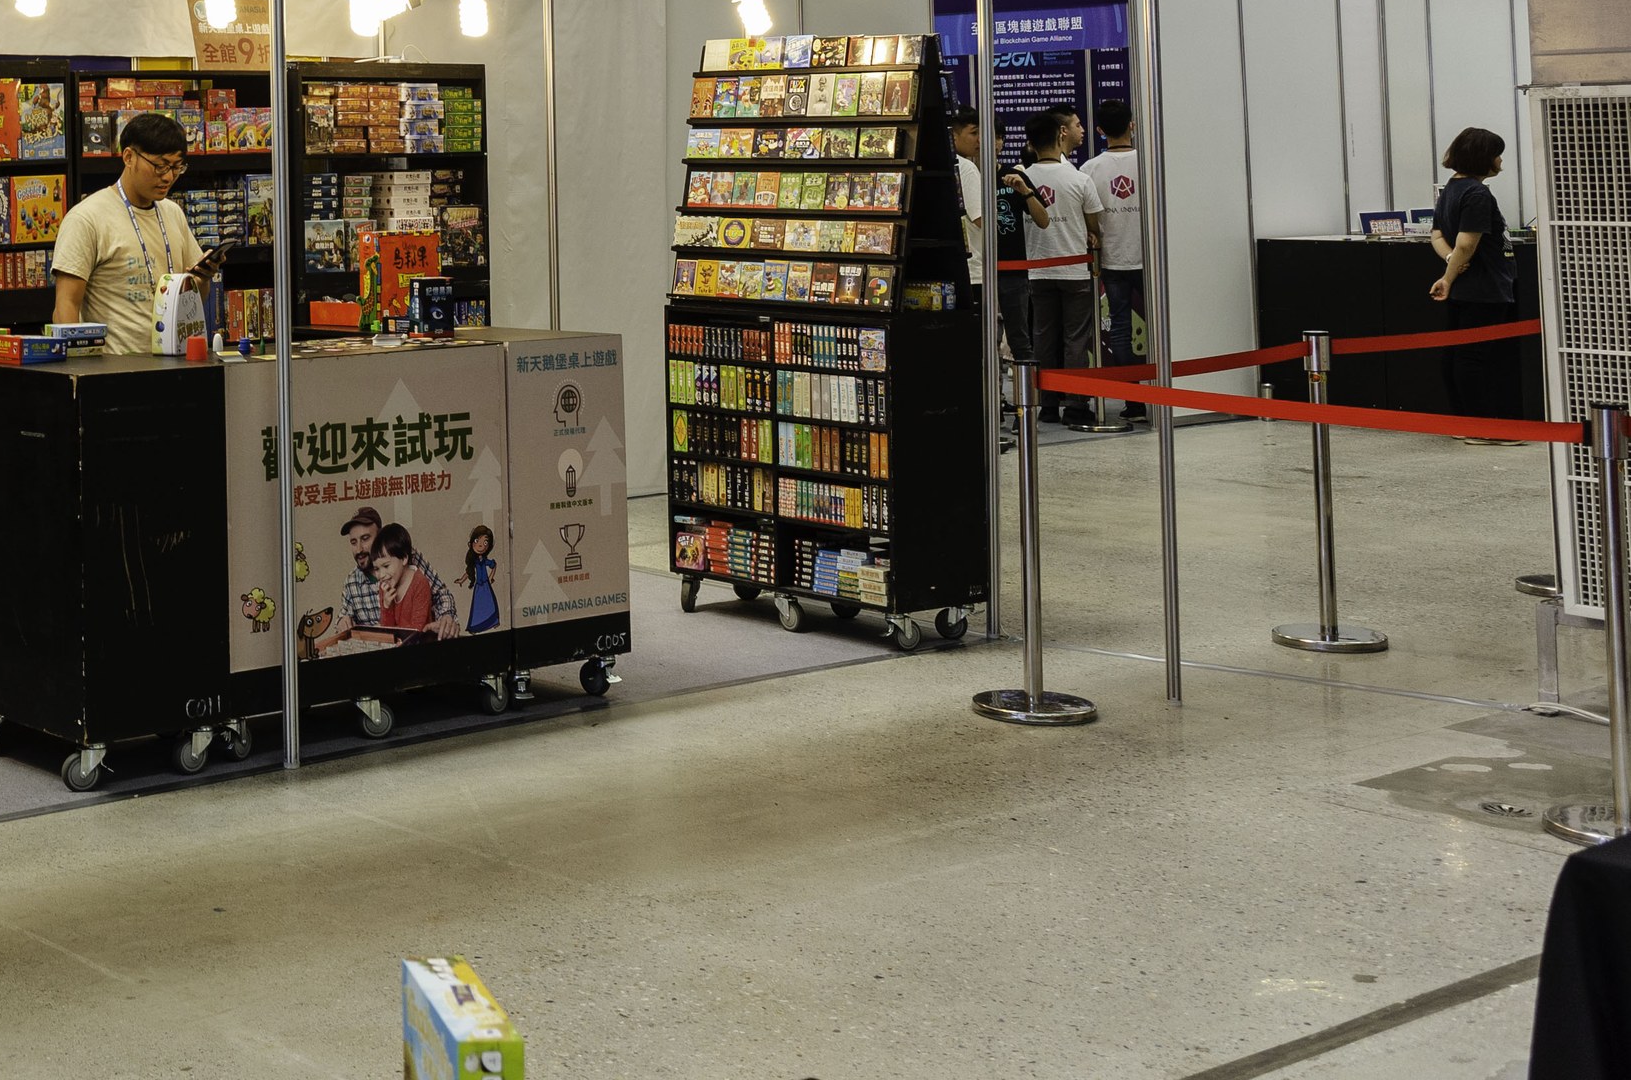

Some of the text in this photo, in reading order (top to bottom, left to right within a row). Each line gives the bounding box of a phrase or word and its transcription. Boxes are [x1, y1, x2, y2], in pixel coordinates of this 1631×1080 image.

[971, 16, 1083, 36] 全區塊鏈遊戲聯盟
[1000, 36, 1030, 45] Blockchain
[1031, 35, 1048, 43] Game
[1049, 34, 1072, 43] Alliance
[127, 256, 156, 269] PLY
[516, 349, 618, 374] 新天鵝堡桌上遊戲
[261, 411, 474, 482] 歡迎來試玩
[522, 592, 627, 618] SWAN PANASIA GAMES
